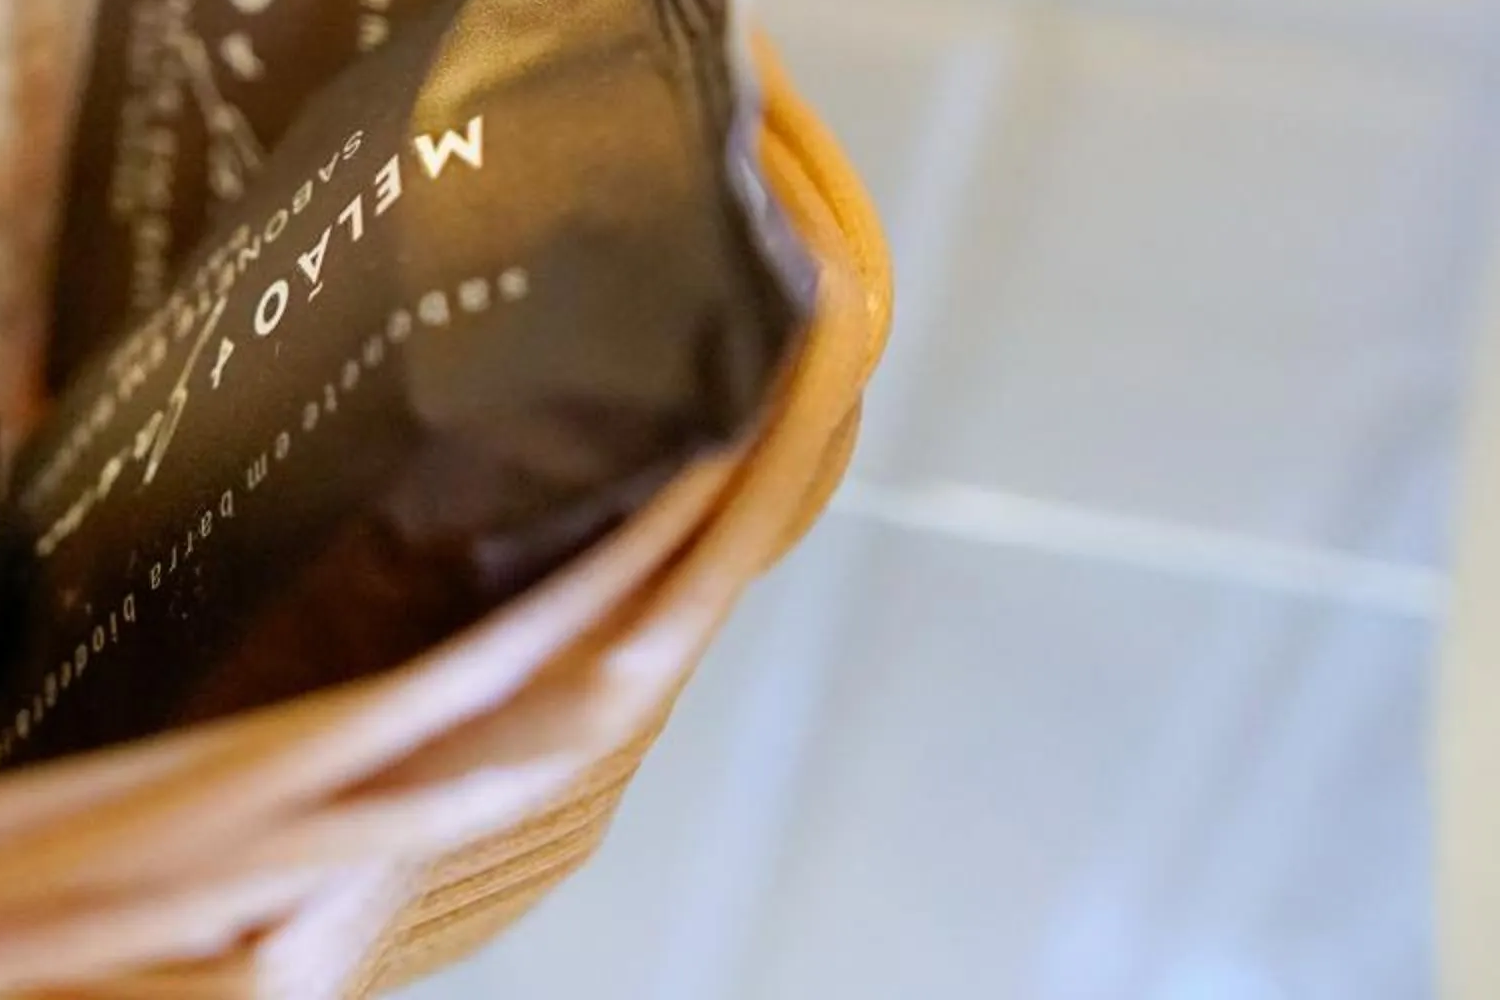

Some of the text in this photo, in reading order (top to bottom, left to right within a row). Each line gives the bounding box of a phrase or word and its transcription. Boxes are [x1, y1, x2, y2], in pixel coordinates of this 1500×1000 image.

[253, 115, 483, 336] MELÃO
[246, 430, 289, 492] em
[150, 489, 233, 591] barra
